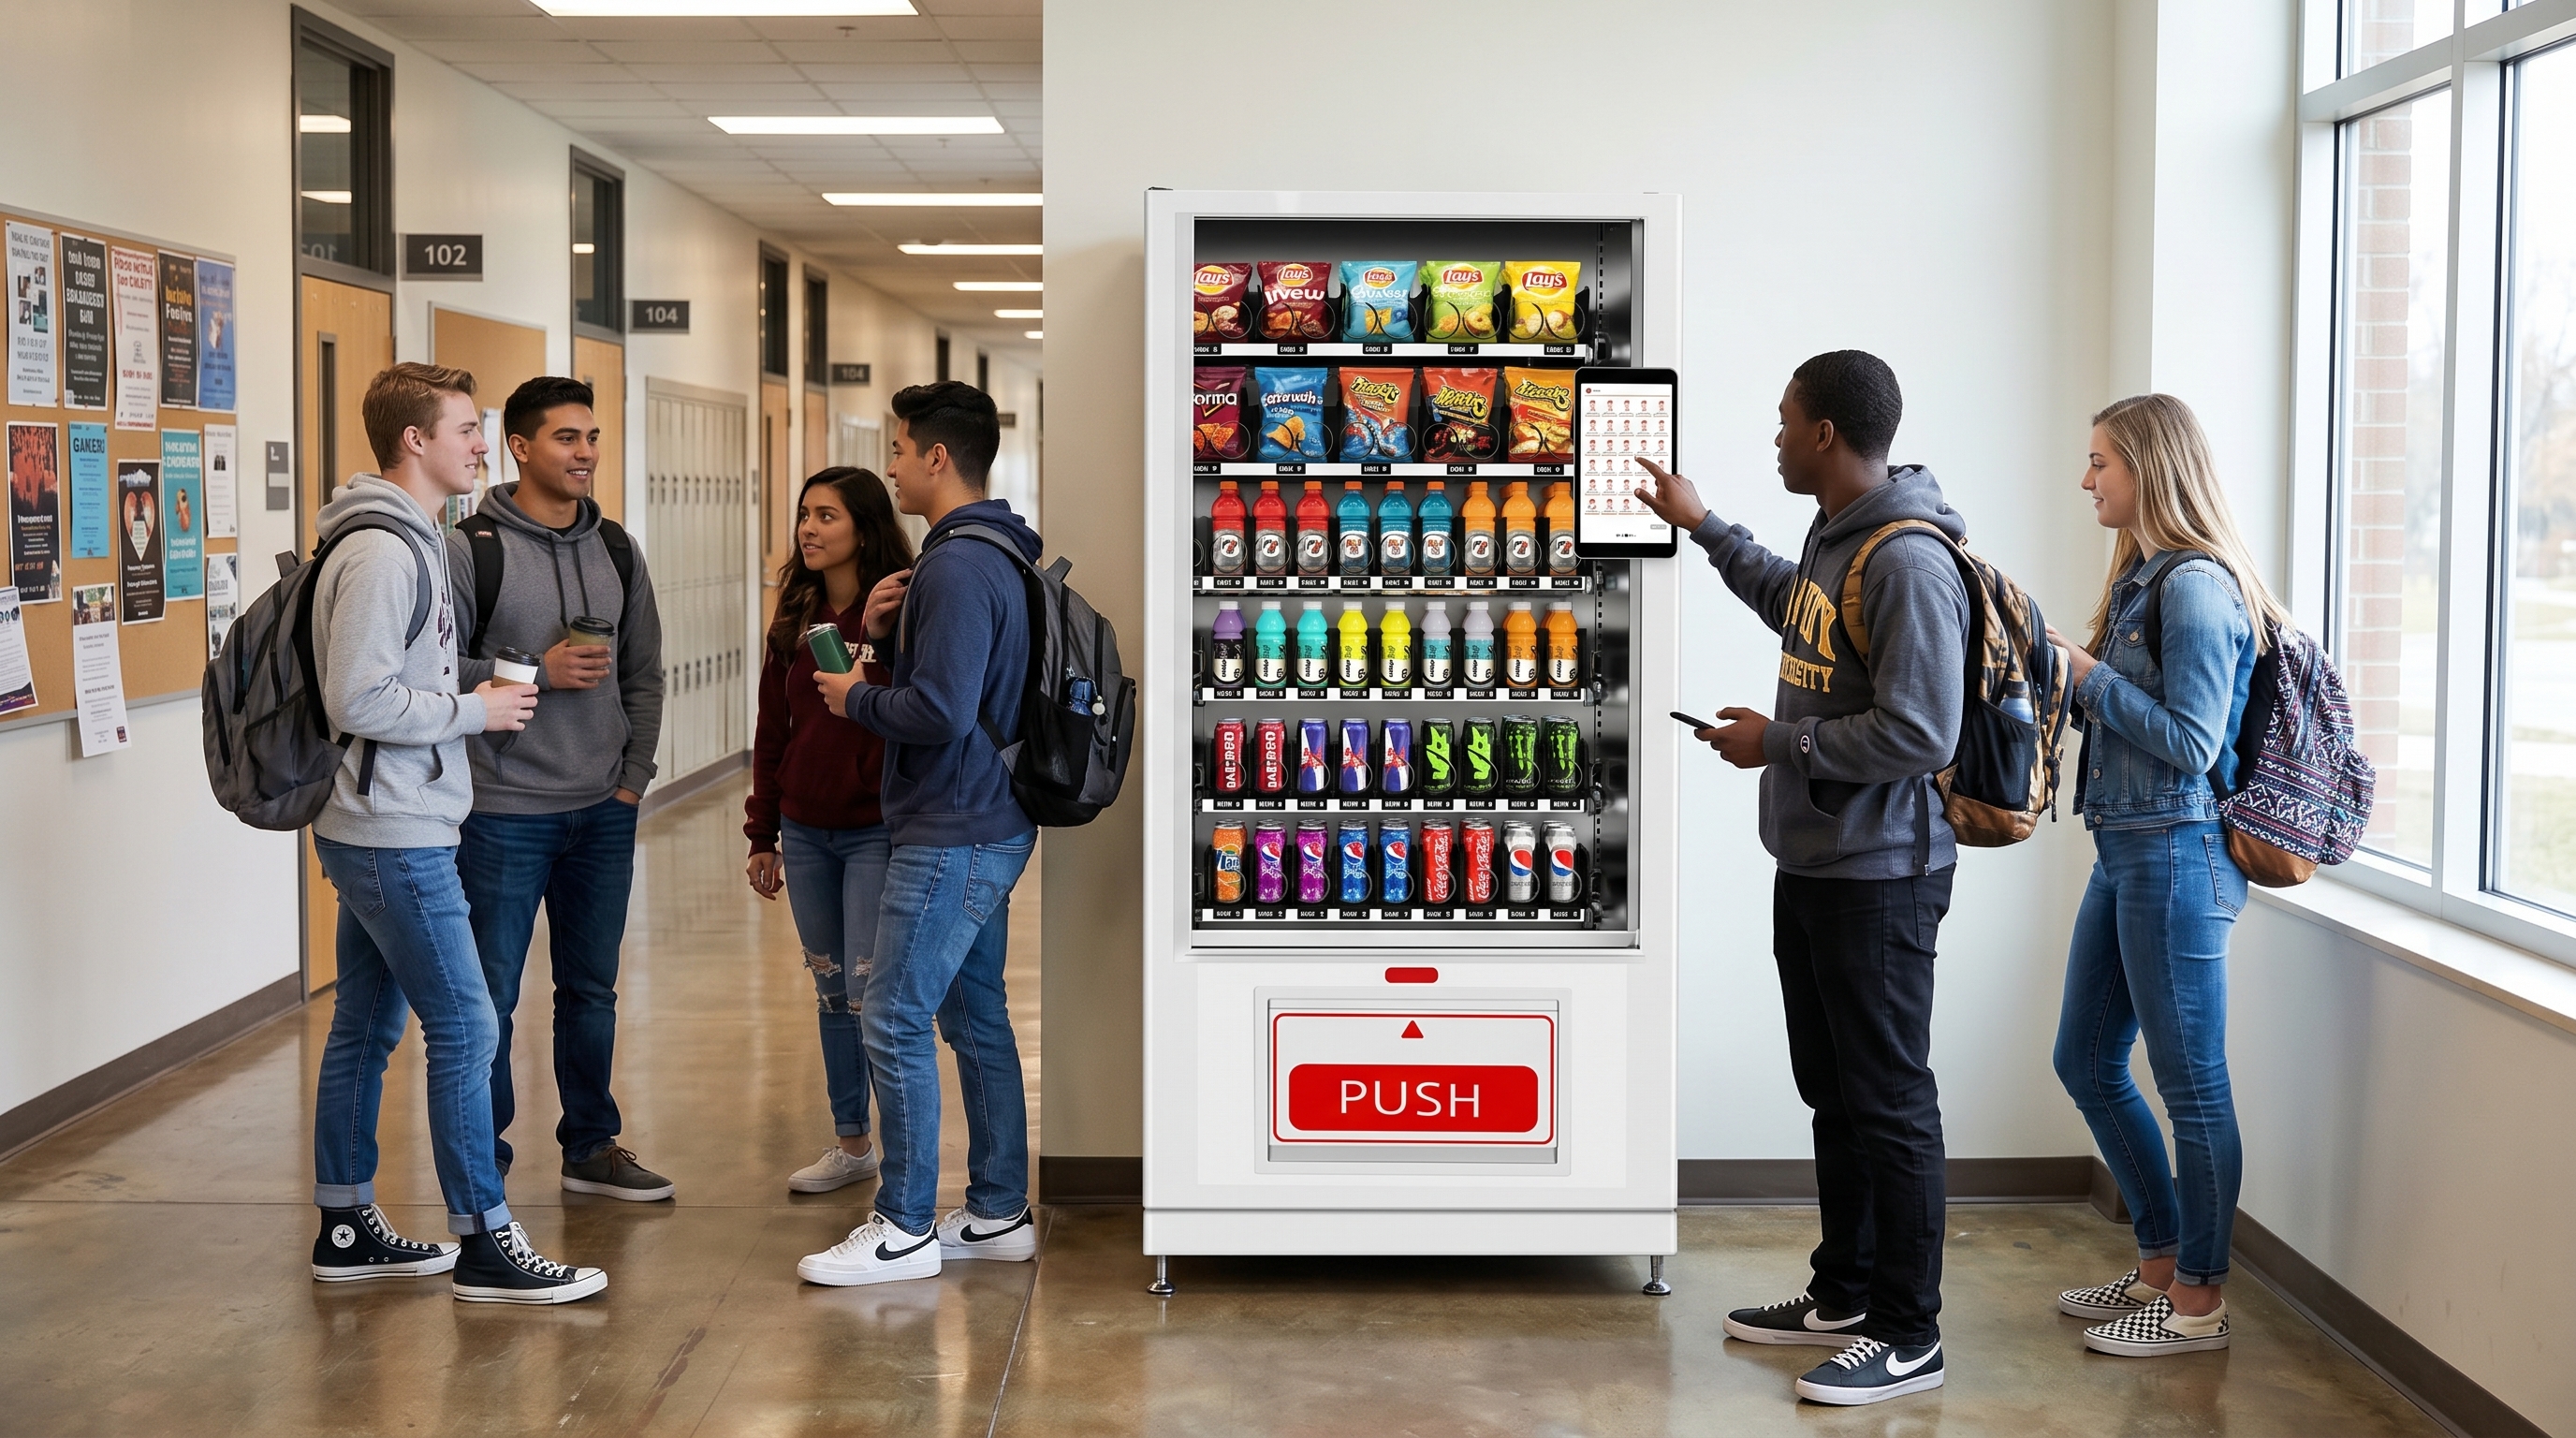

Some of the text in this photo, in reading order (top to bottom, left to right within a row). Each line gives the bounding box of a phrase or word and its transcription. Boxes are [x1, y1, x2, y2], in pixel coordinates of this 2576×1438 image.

[424, 243, 467, 266] 102
[645, 305, 679, 324] 104
[1339, 1079, 1480, 1118] PUSH
